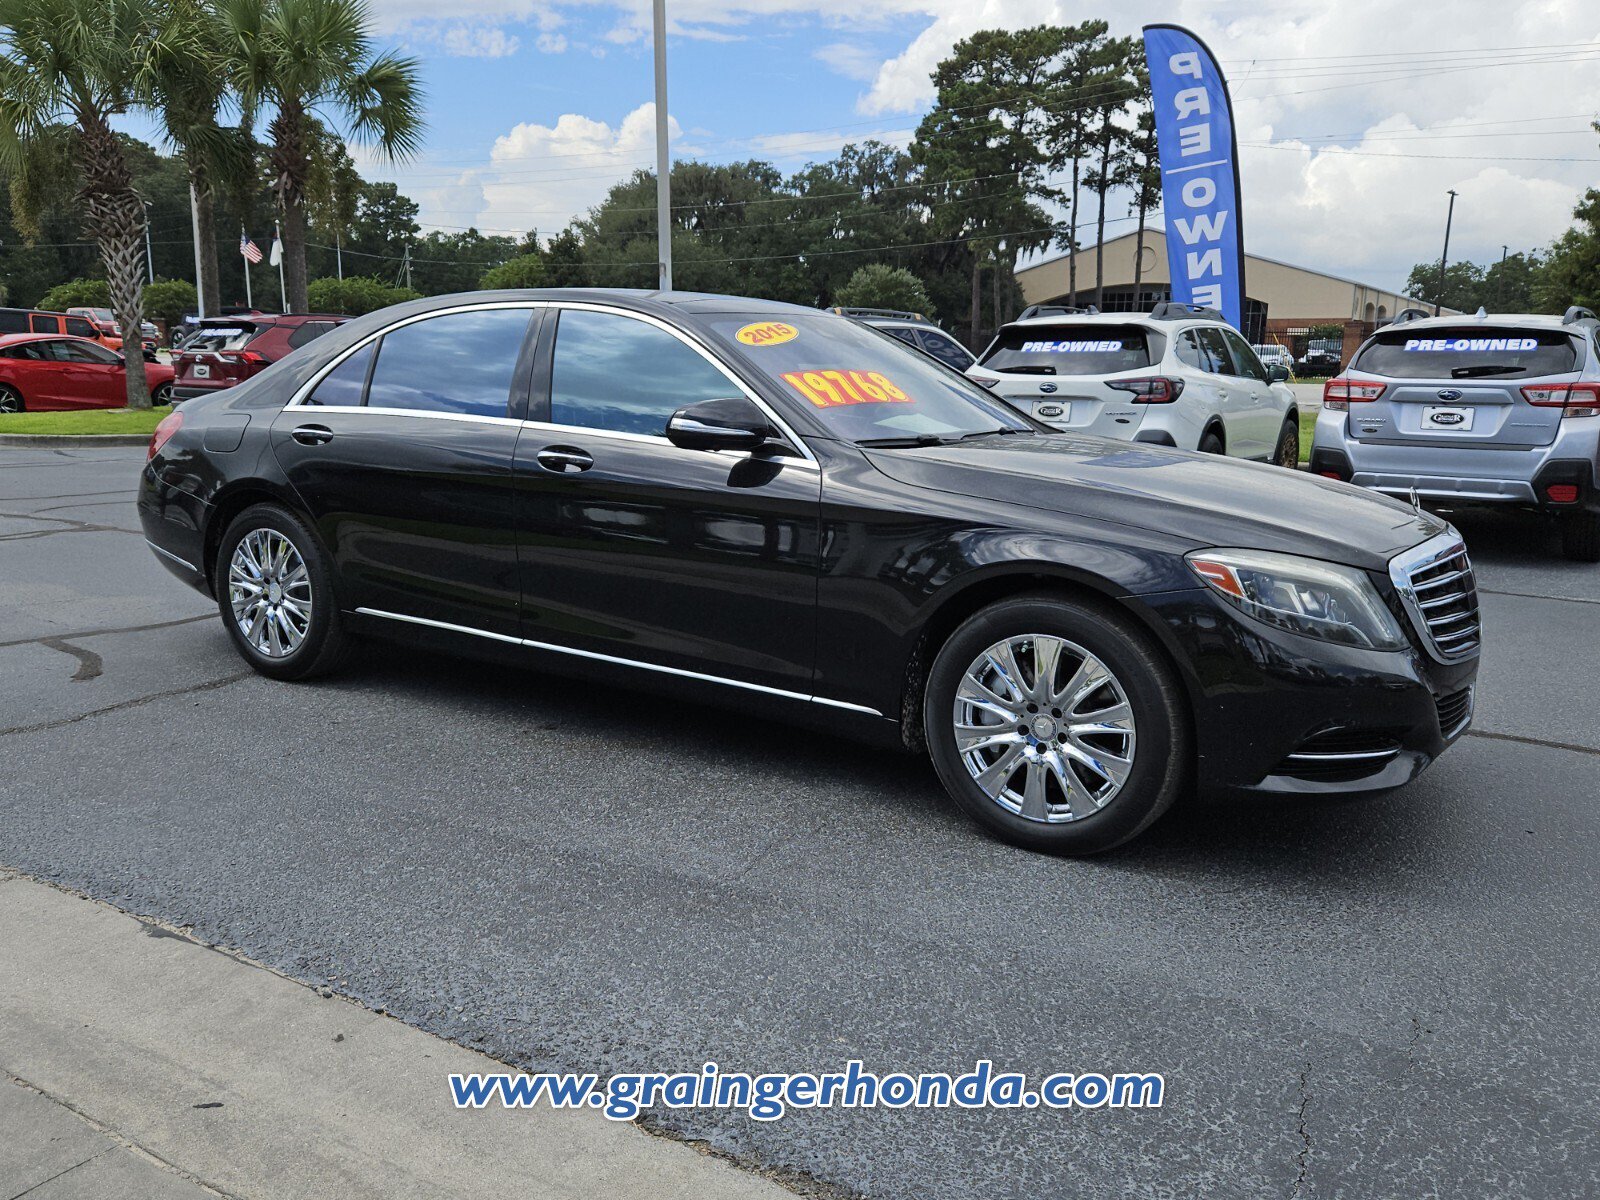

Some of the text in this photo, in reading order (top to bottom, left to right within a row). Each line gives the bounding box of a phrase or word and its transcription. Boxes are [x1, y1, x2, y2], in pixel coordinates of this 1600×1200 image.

[744, 324, 792, 344] 2015
[1021, 340, 1122, 352] PRE-OWNED
[1404, 338, 1538, 351] PRE-OWNED
[784, 370, 910, 406] 19768
